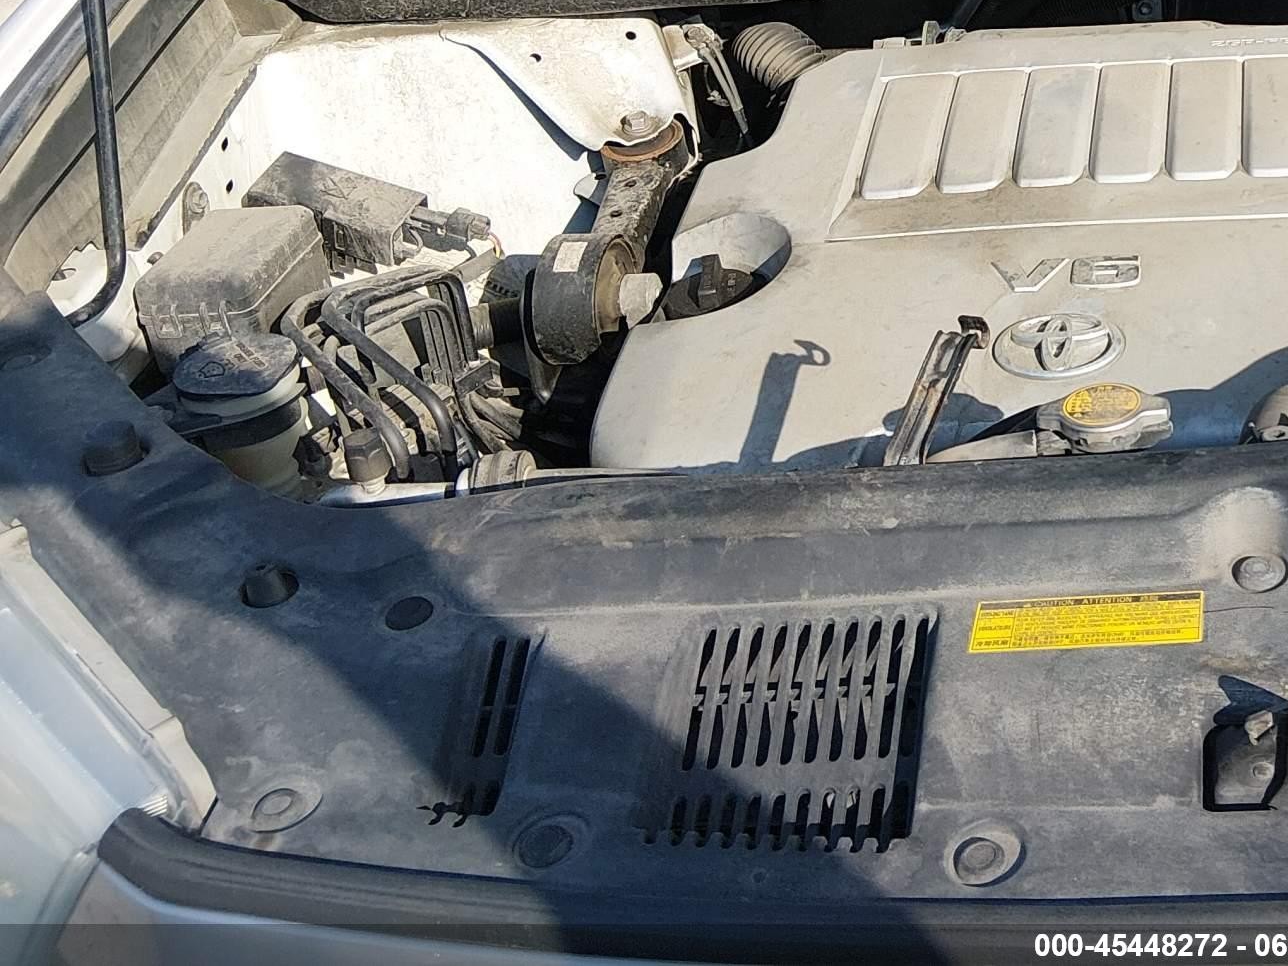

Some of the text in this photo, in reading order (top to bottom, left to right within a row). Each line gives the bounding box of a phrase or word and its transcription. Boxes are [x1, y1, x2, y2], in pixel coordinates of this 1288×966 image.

[991, 255, 1142, 292] V6
[1034, 598, 1075, 608] CAUTION
[1081, 596, 1132, 605] ATTENTION
